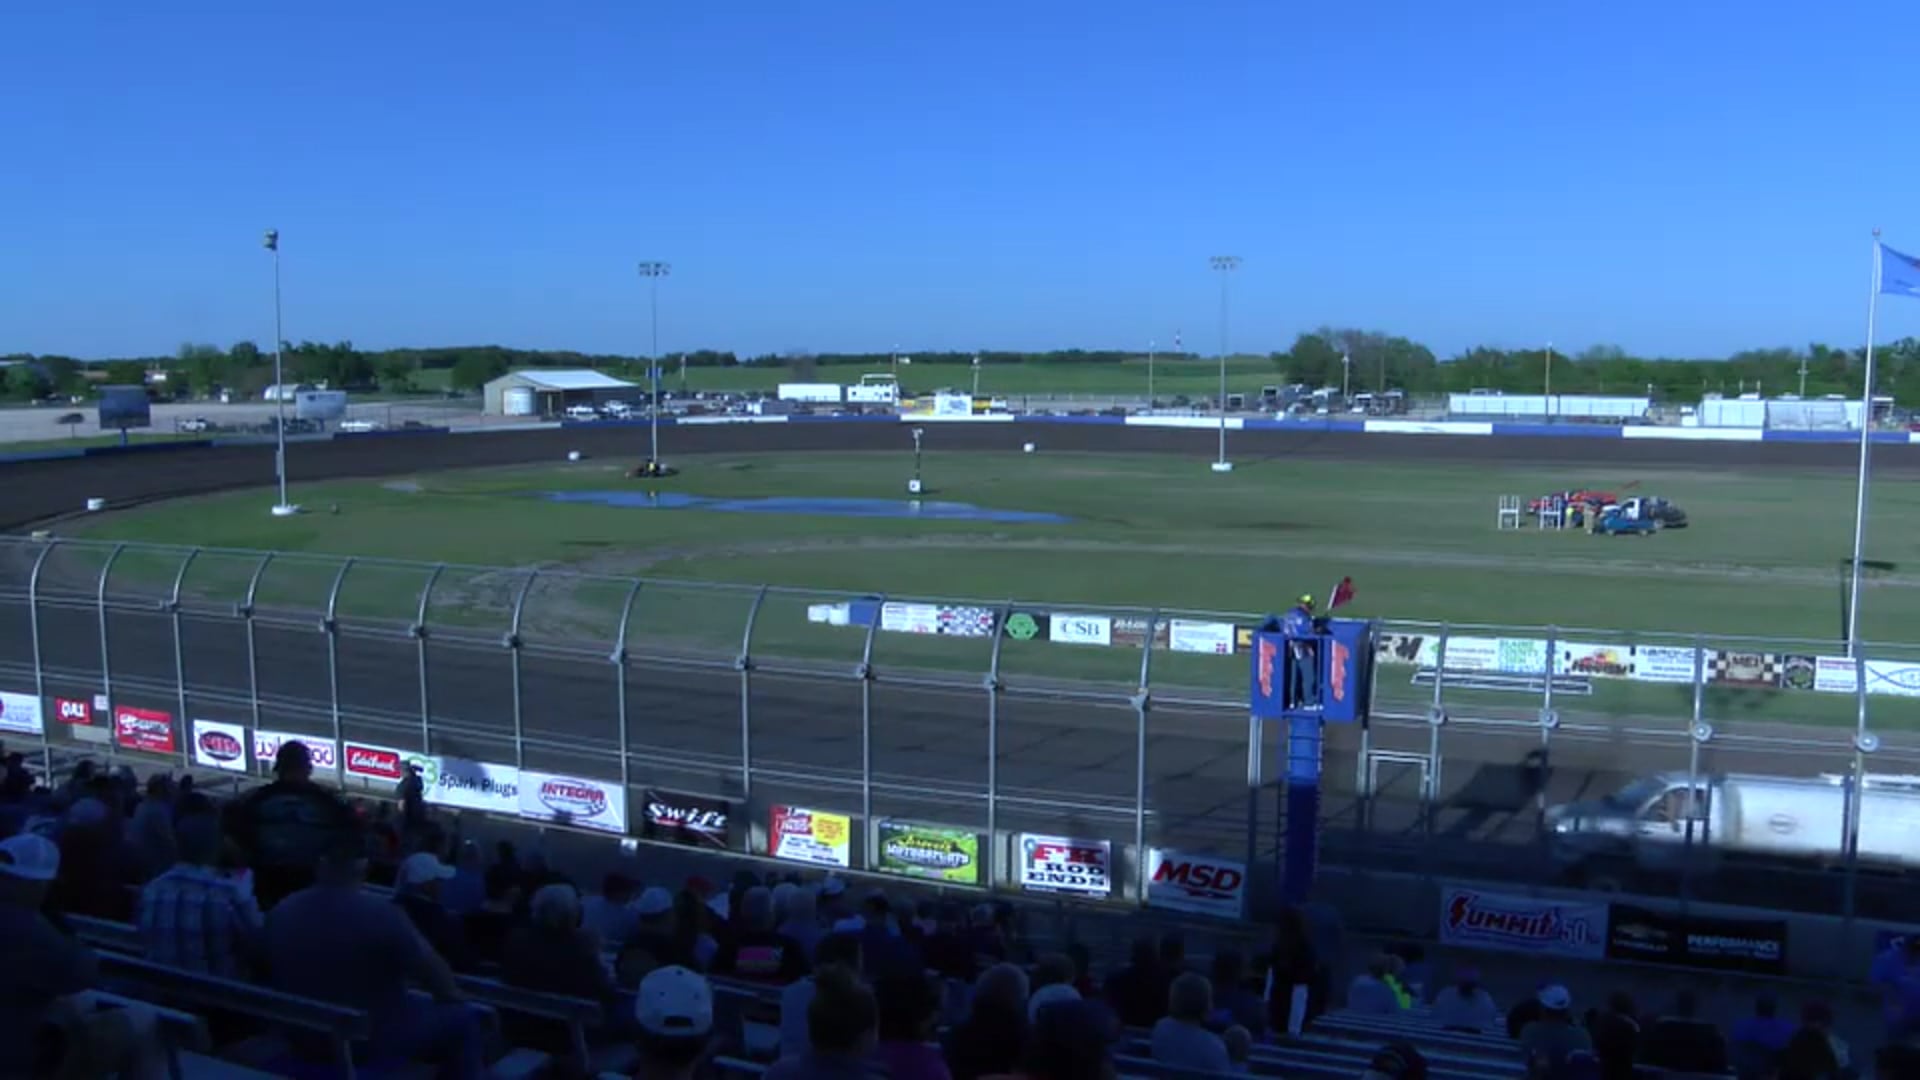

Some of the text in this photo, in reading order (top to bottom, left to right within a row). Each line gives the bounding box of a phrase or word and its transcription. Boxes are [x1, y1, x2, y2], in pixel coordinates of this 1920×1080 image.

[439, 772, 477, 790] Spark
[481, 778, 519, 798] Plugs
[542, 782, 605, 801] INTEGRA
[646, 801, 728, 829] Swift
[1033, 845, 1105, 865] FK
[1027, 871, 1105, 887] ENDS
[1045, 863, 1105, 875] ROD
[1154, 861, 1241, 890] MSD
